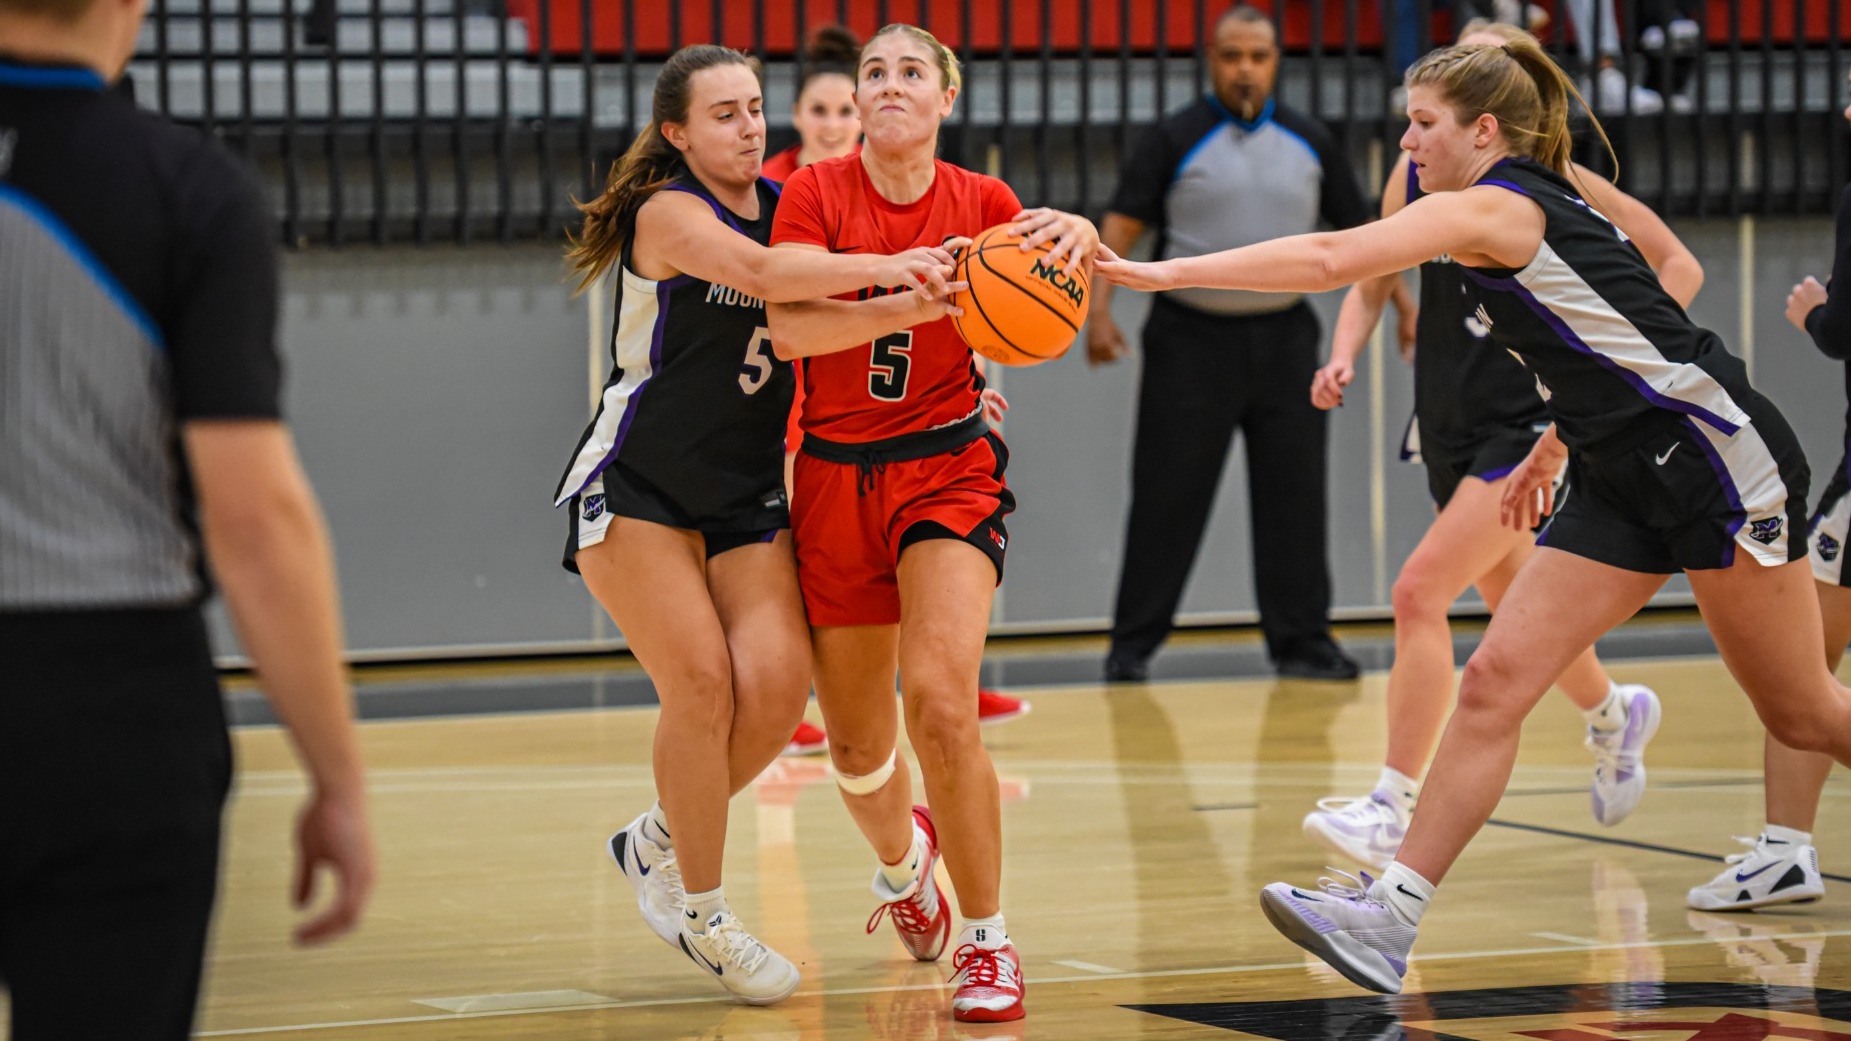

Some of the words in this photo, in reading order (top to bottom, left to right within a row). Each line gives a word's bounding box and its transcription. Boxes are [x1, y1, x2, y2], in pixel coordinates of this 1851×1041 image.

[1030, 258, 1084, 309] NCAA
[738, 326, 773, 395] 5
[868, 330, 913, 402] 5
